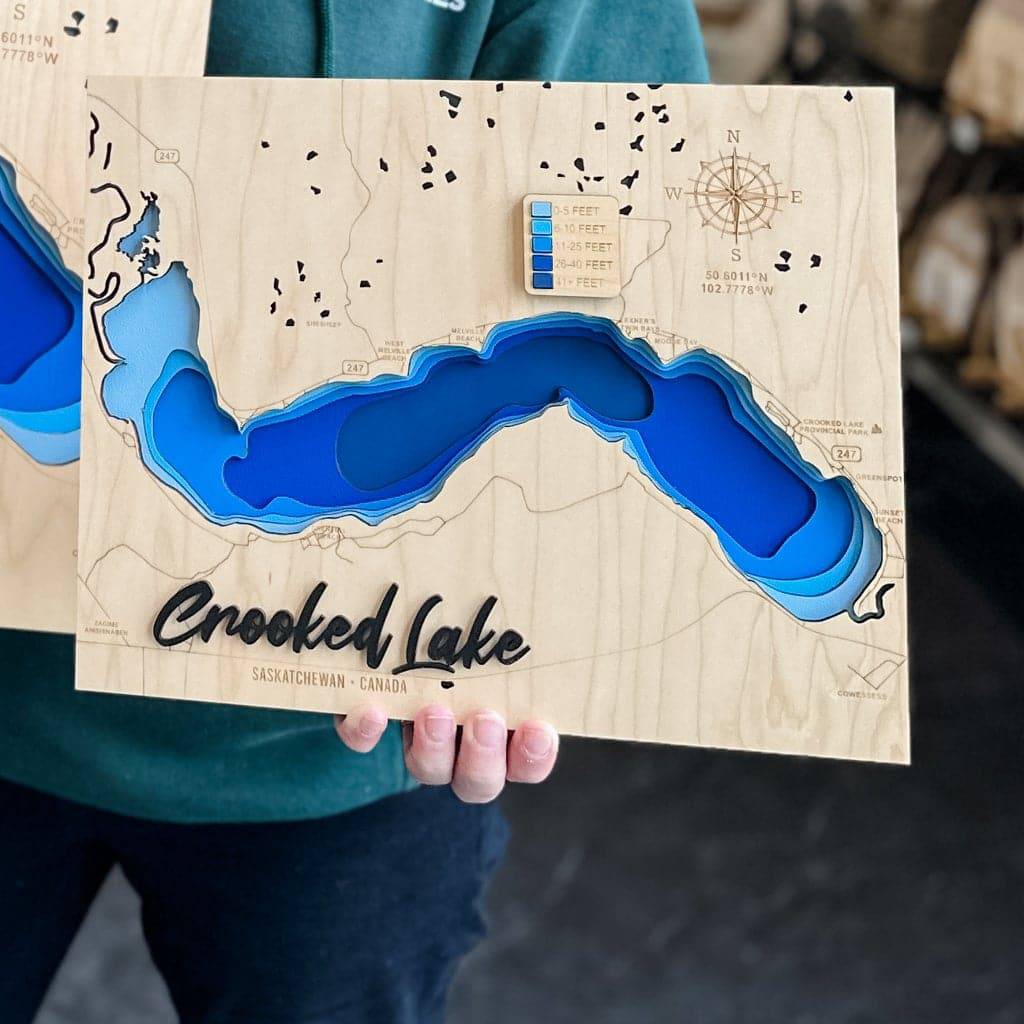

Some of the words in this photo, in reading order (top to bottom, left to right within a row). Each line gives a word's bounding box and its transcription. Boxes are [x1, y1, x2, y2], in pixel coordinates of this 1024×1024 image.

[13, 3, 27, 21] S
[726, 129, 741, 144] N
[159, 151, 176, 161] 247
[664, 186, 683, 201] W
[790, 190, 803, 204] E
[572, 206, 600, 217] FEET
[578, 224, 607, 234] FEET
[584, 241, 613, 253] FEET
[731, 248, 742, 262] S
[585, 259, 613, 271] FEET
[576, 277, 604, 288] FEET
[347, 363, 364, 373] 247
[802, 418, 842, 427] CROOKED
[843, 420, 865, 428] LAKE
[836, 449, 857, 459] 247
[152, 579, 400, 670] Crooked
[391, 594, 532, 675] Lake
[252, 666, 346, 689] SASKATCHEWAN
[359, 676, 408, 694] CANADA
